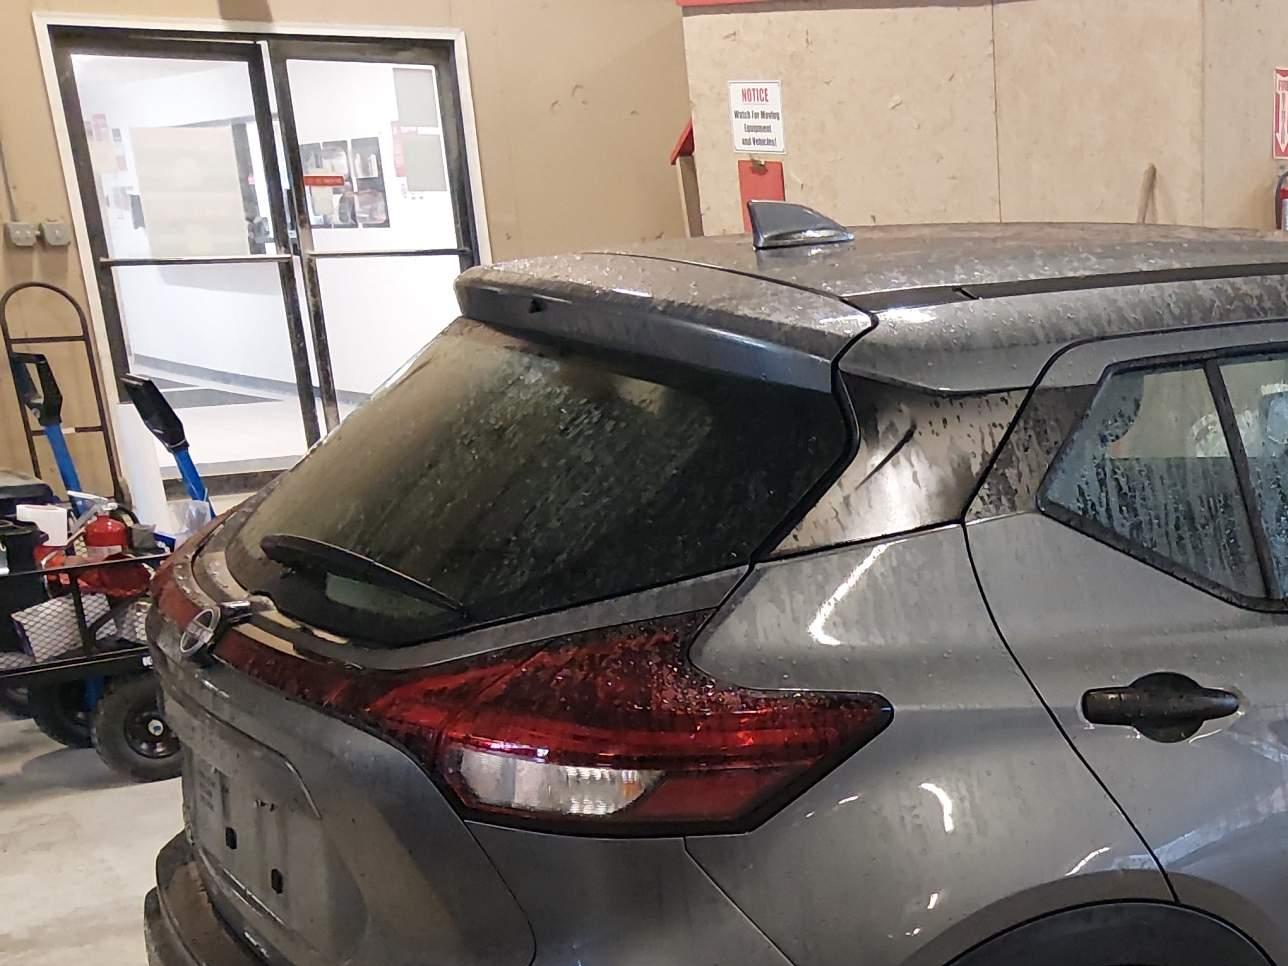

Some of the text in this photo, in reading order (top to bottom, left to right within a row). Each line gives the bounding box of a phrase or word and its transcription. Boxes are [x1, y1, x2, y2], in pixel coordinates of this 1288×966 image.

[741, 87, 769, 102] NOTICE
[734, 110, 780, 121] Watch For Moving
[742, 137, 752, 146] and
